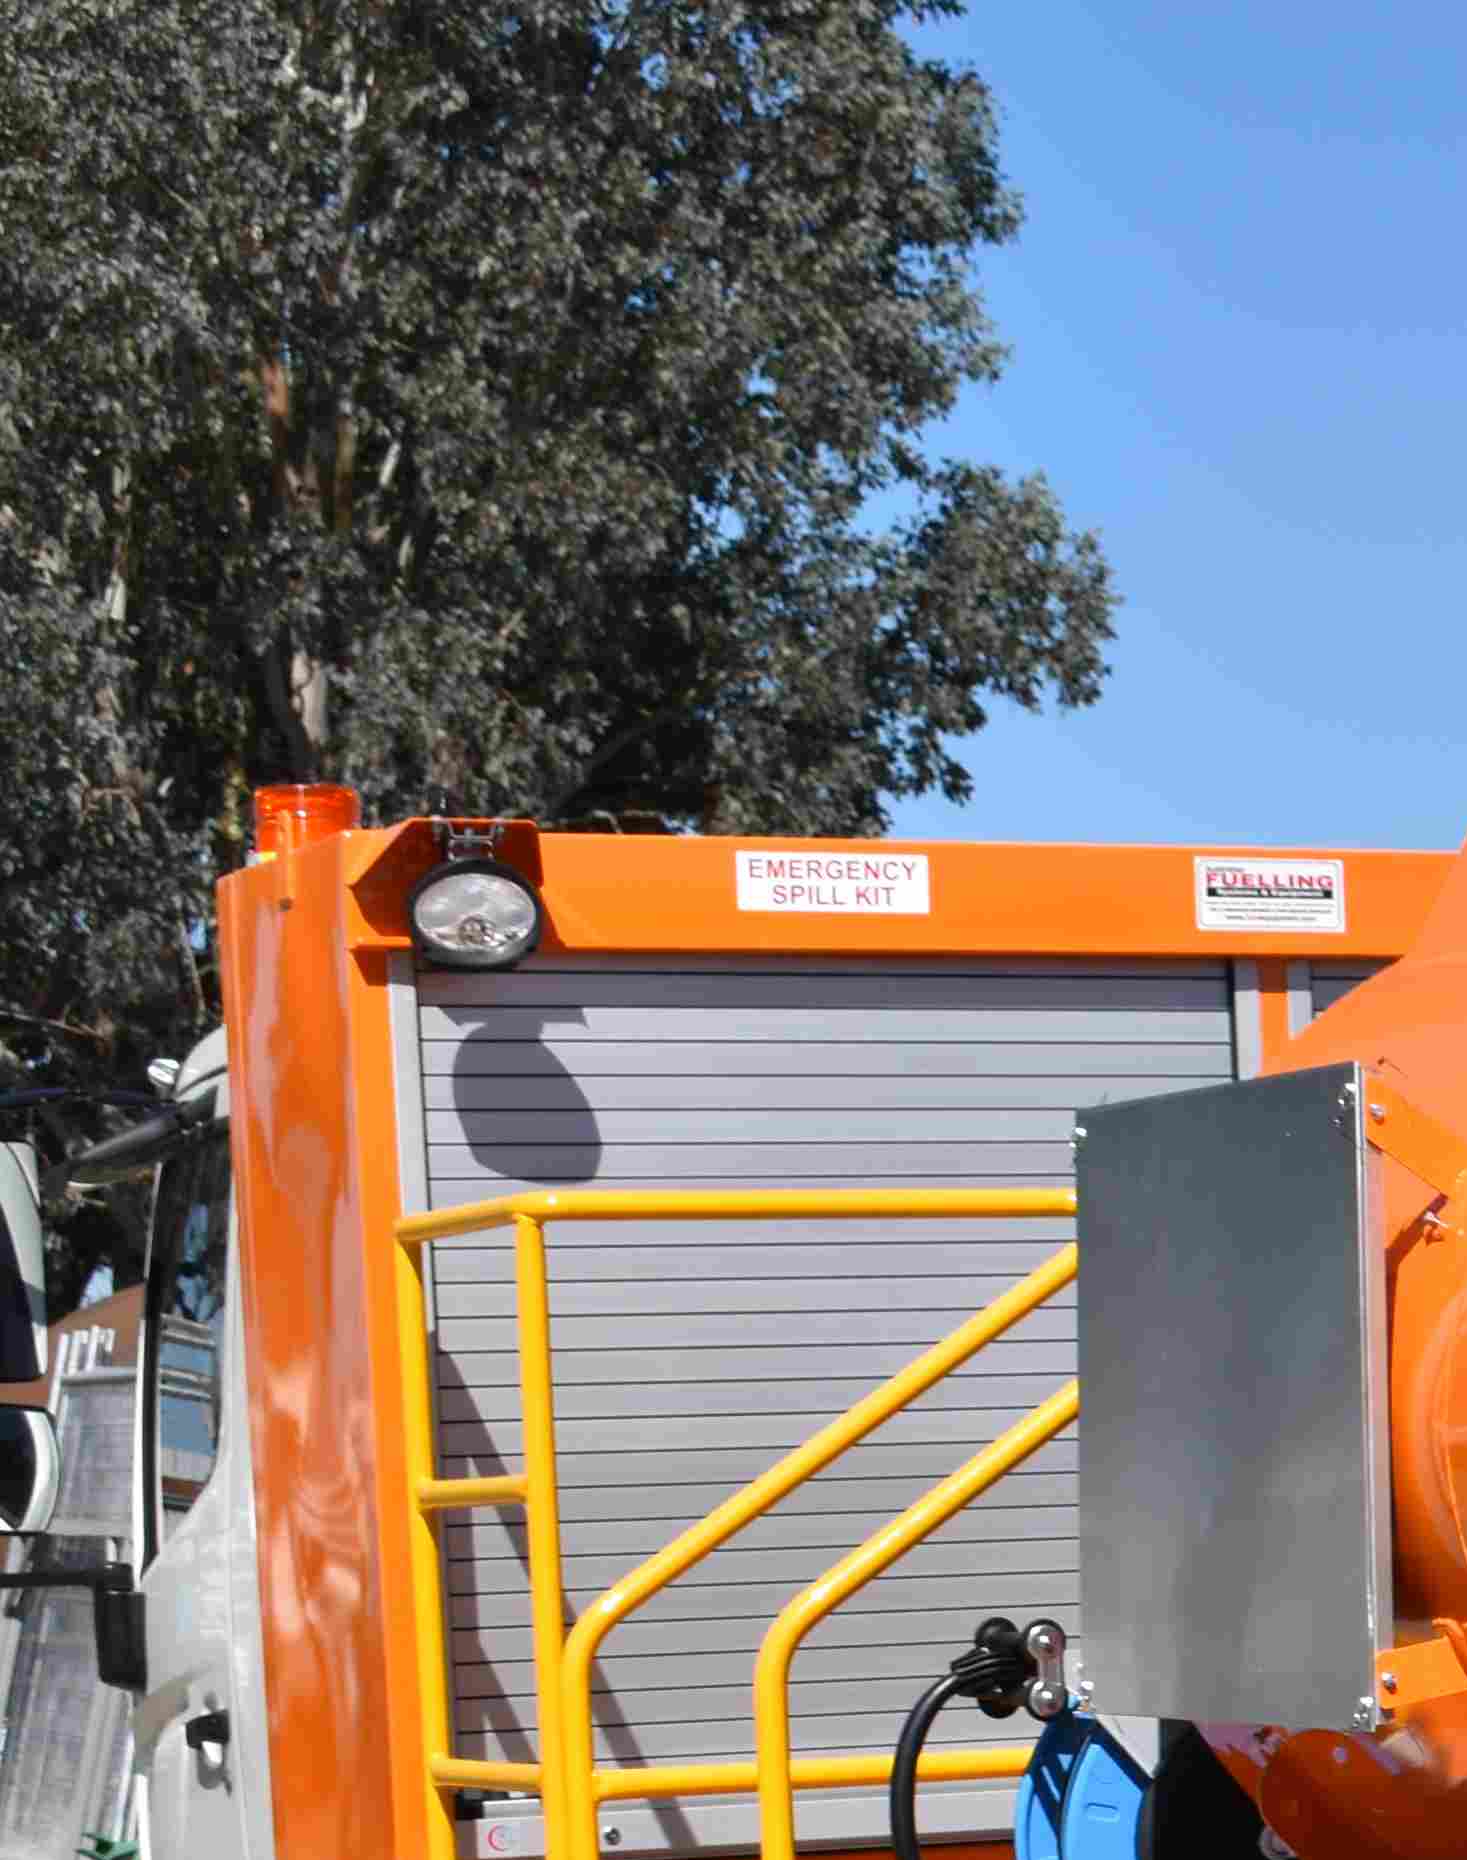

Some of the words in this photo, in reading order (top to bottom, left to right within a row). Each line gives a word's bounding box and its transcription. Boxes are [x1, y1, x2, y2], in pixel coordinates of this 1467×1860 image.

[748, 858, 915, 881] EMERGENCY
[1206, 872, 1334, 888] FUELLING
[772, 884, 847, 905] SPILL
[855, 886, 895, 907] KIT
